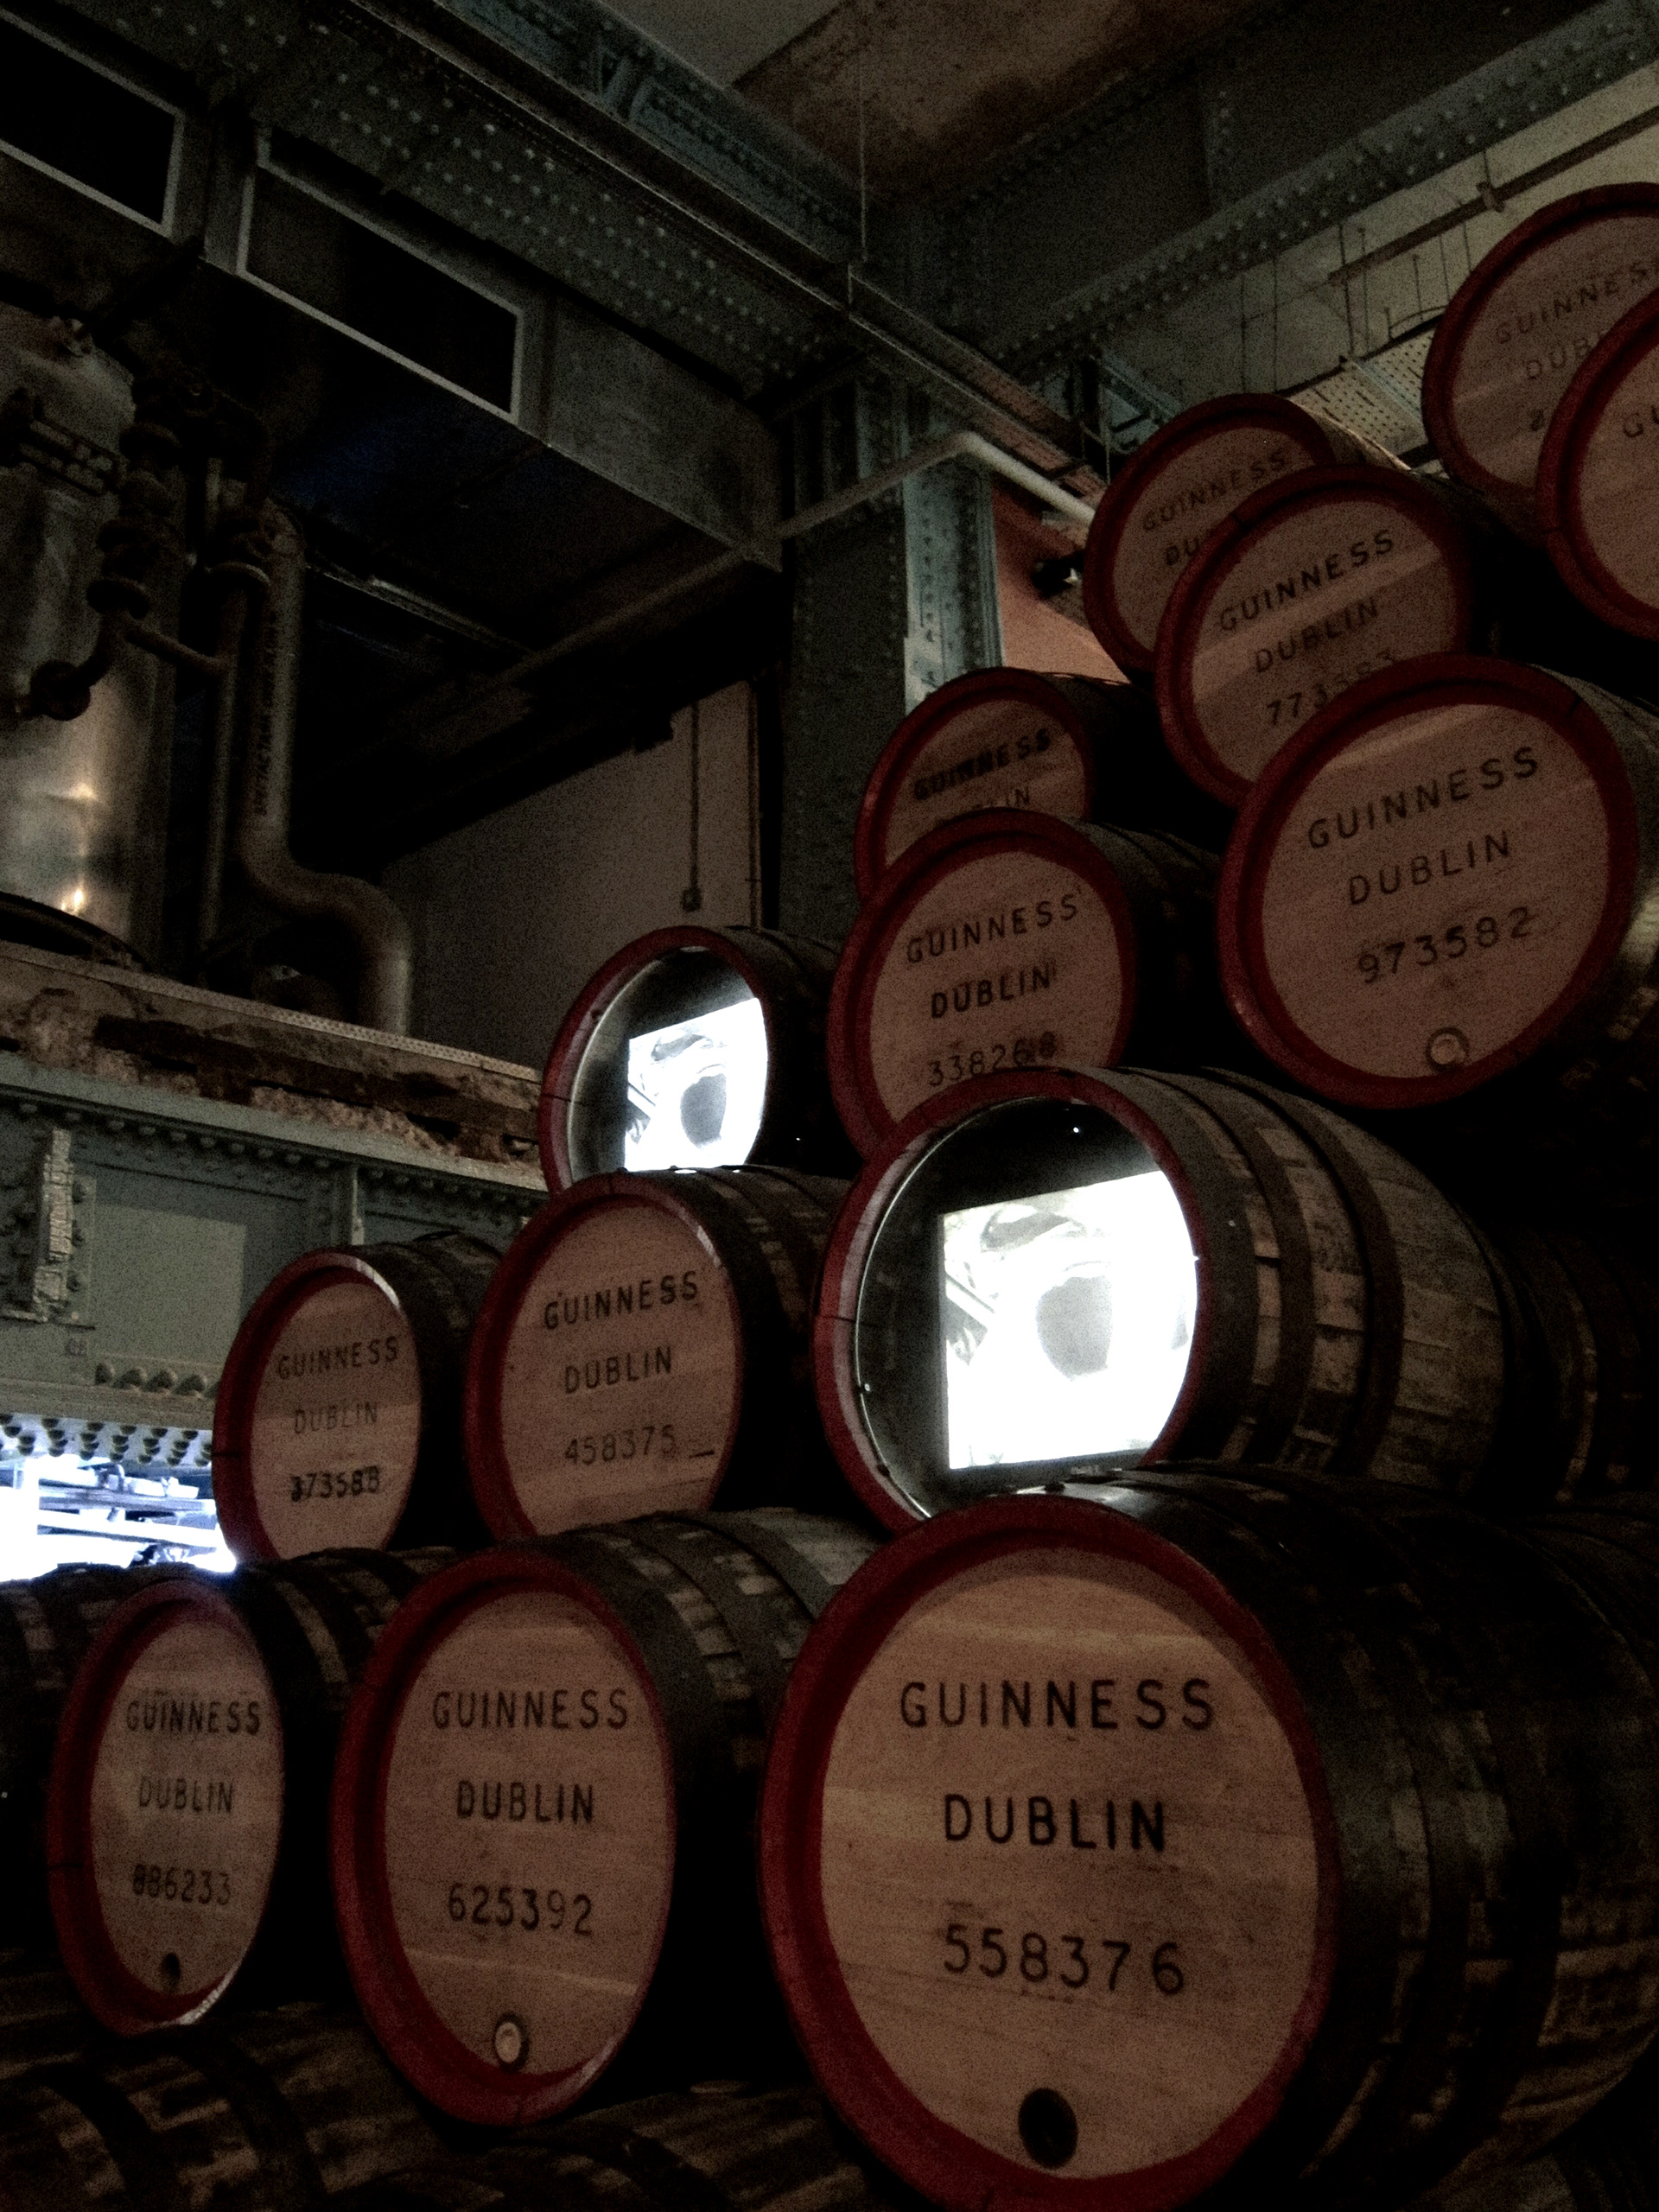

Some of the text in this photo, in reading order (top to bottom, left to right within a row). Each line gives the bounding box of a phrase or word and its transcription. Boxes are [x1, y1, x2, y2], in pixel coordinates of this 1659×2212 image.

[1496, 255, 1659, 344] GUINNES
[1142, 447, 1287, 531] GUINNESS
[1220, 529, 1394, 632] GUINNESS
[1256, 596, 1379, 673] DUBLIN
[912, 728, 1052, 801] GUINNESS
[1307, 747, 1538, 849] GUINNESS
[1349, 830, 1510, 905] DUBLIN
[907, 893, 1078, 964] GUINNESS
[1358, 906, 1533, 983] 973582
[931, 964, 1052, 1019] DUBLIN
[543, 1270, 698, 1331] GUINNESS
[276, 1336, 399, 1380] GUINNESS
[565, 1346, 672, 1394] DUBLIN
[294, 1402, 378, 1434] DUBLIN
[564, 1423, 677, 1466] 458375
[125, 1699, 261, 1735] GUINNESS
[433, 1688, 629, 1730] GUINNESS
[900, 1679, 1212, 1730] GUINNESS
[138, 1775, 234, 1814] DUBLIN
[455, 1781, 594, 1824] DUBLIN
[944, 1794, 1166, 1852] DUBLIN
[448, 1882, 594, 1936] 625392
[944, 1923, 1184, 1994] 558376
